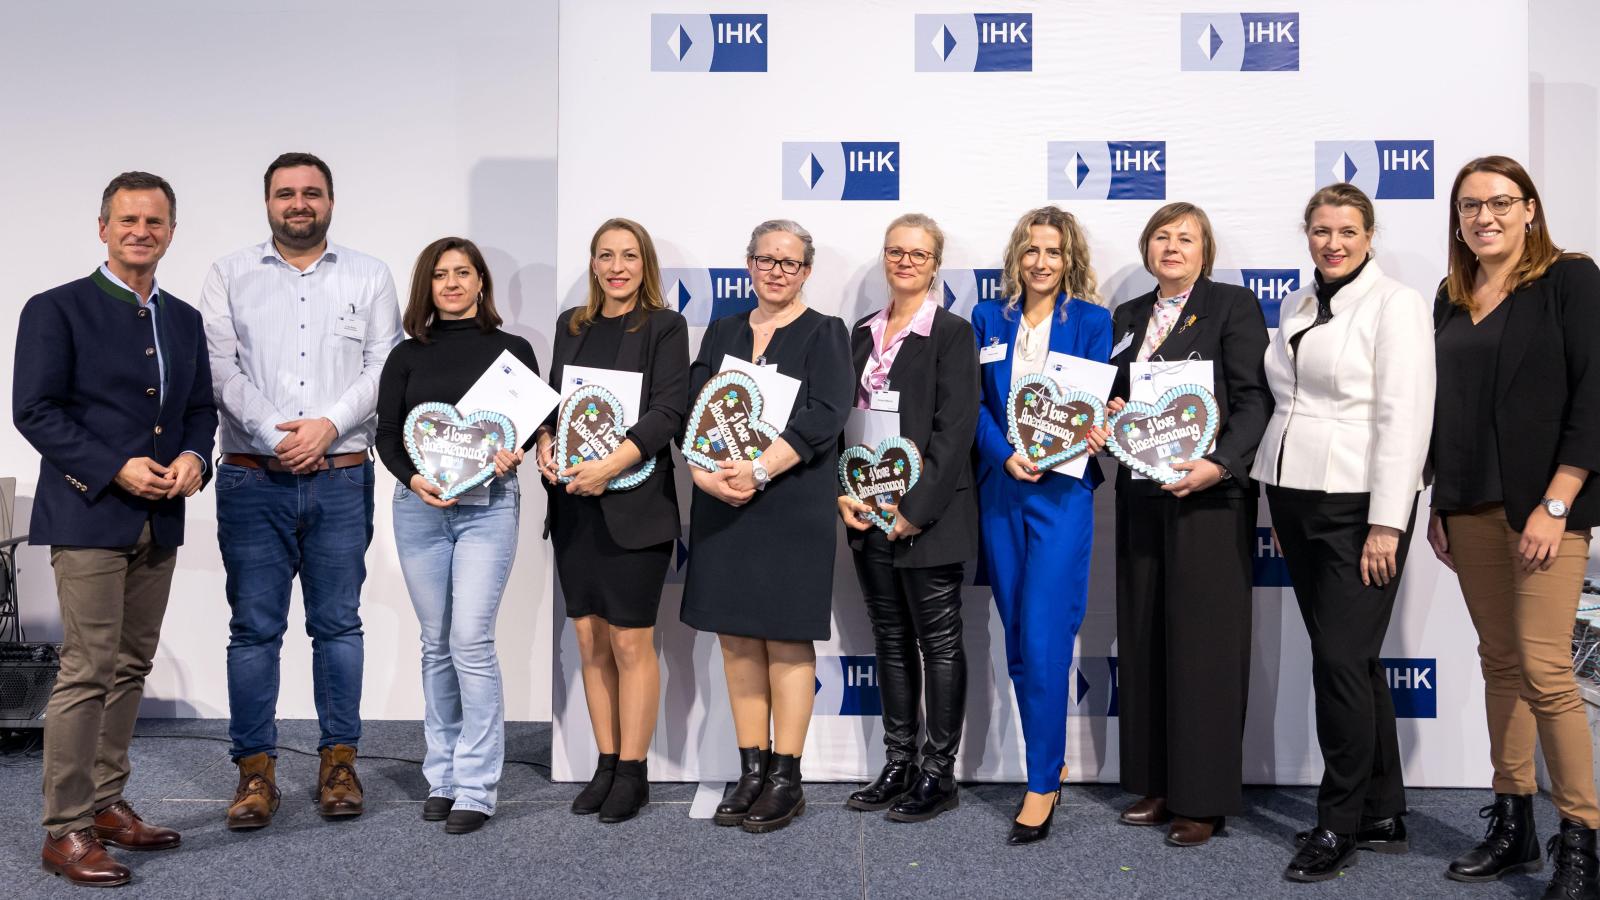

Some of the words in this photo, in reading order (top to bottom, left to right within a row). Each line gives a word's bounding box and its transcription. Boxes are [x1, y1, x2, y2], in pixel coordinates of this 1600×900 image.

[718, 23, 763, 44] IHK
[982, 23, 1028, 44] IHK
[1249, 22, 1295, 43] IHK
[849, 151, 895, 172] IHK
[1115, 151, 1162, 171] IHK
[1383, 150, 1429, 171] IHK
[982, 278, 1004, 299] IH
[1249, 278, 1294, 299] IHK
[1049, 404, 1069, 424] love
[1153, 415, 1176, 431] love
[451, 426, 473, 444] love
[570, 414, 610, 460] Anerkenn
[733, 418, 751, 443] love
[847, 665, 879, 687] IH
[1385, 667, 1432, 689] IHK
